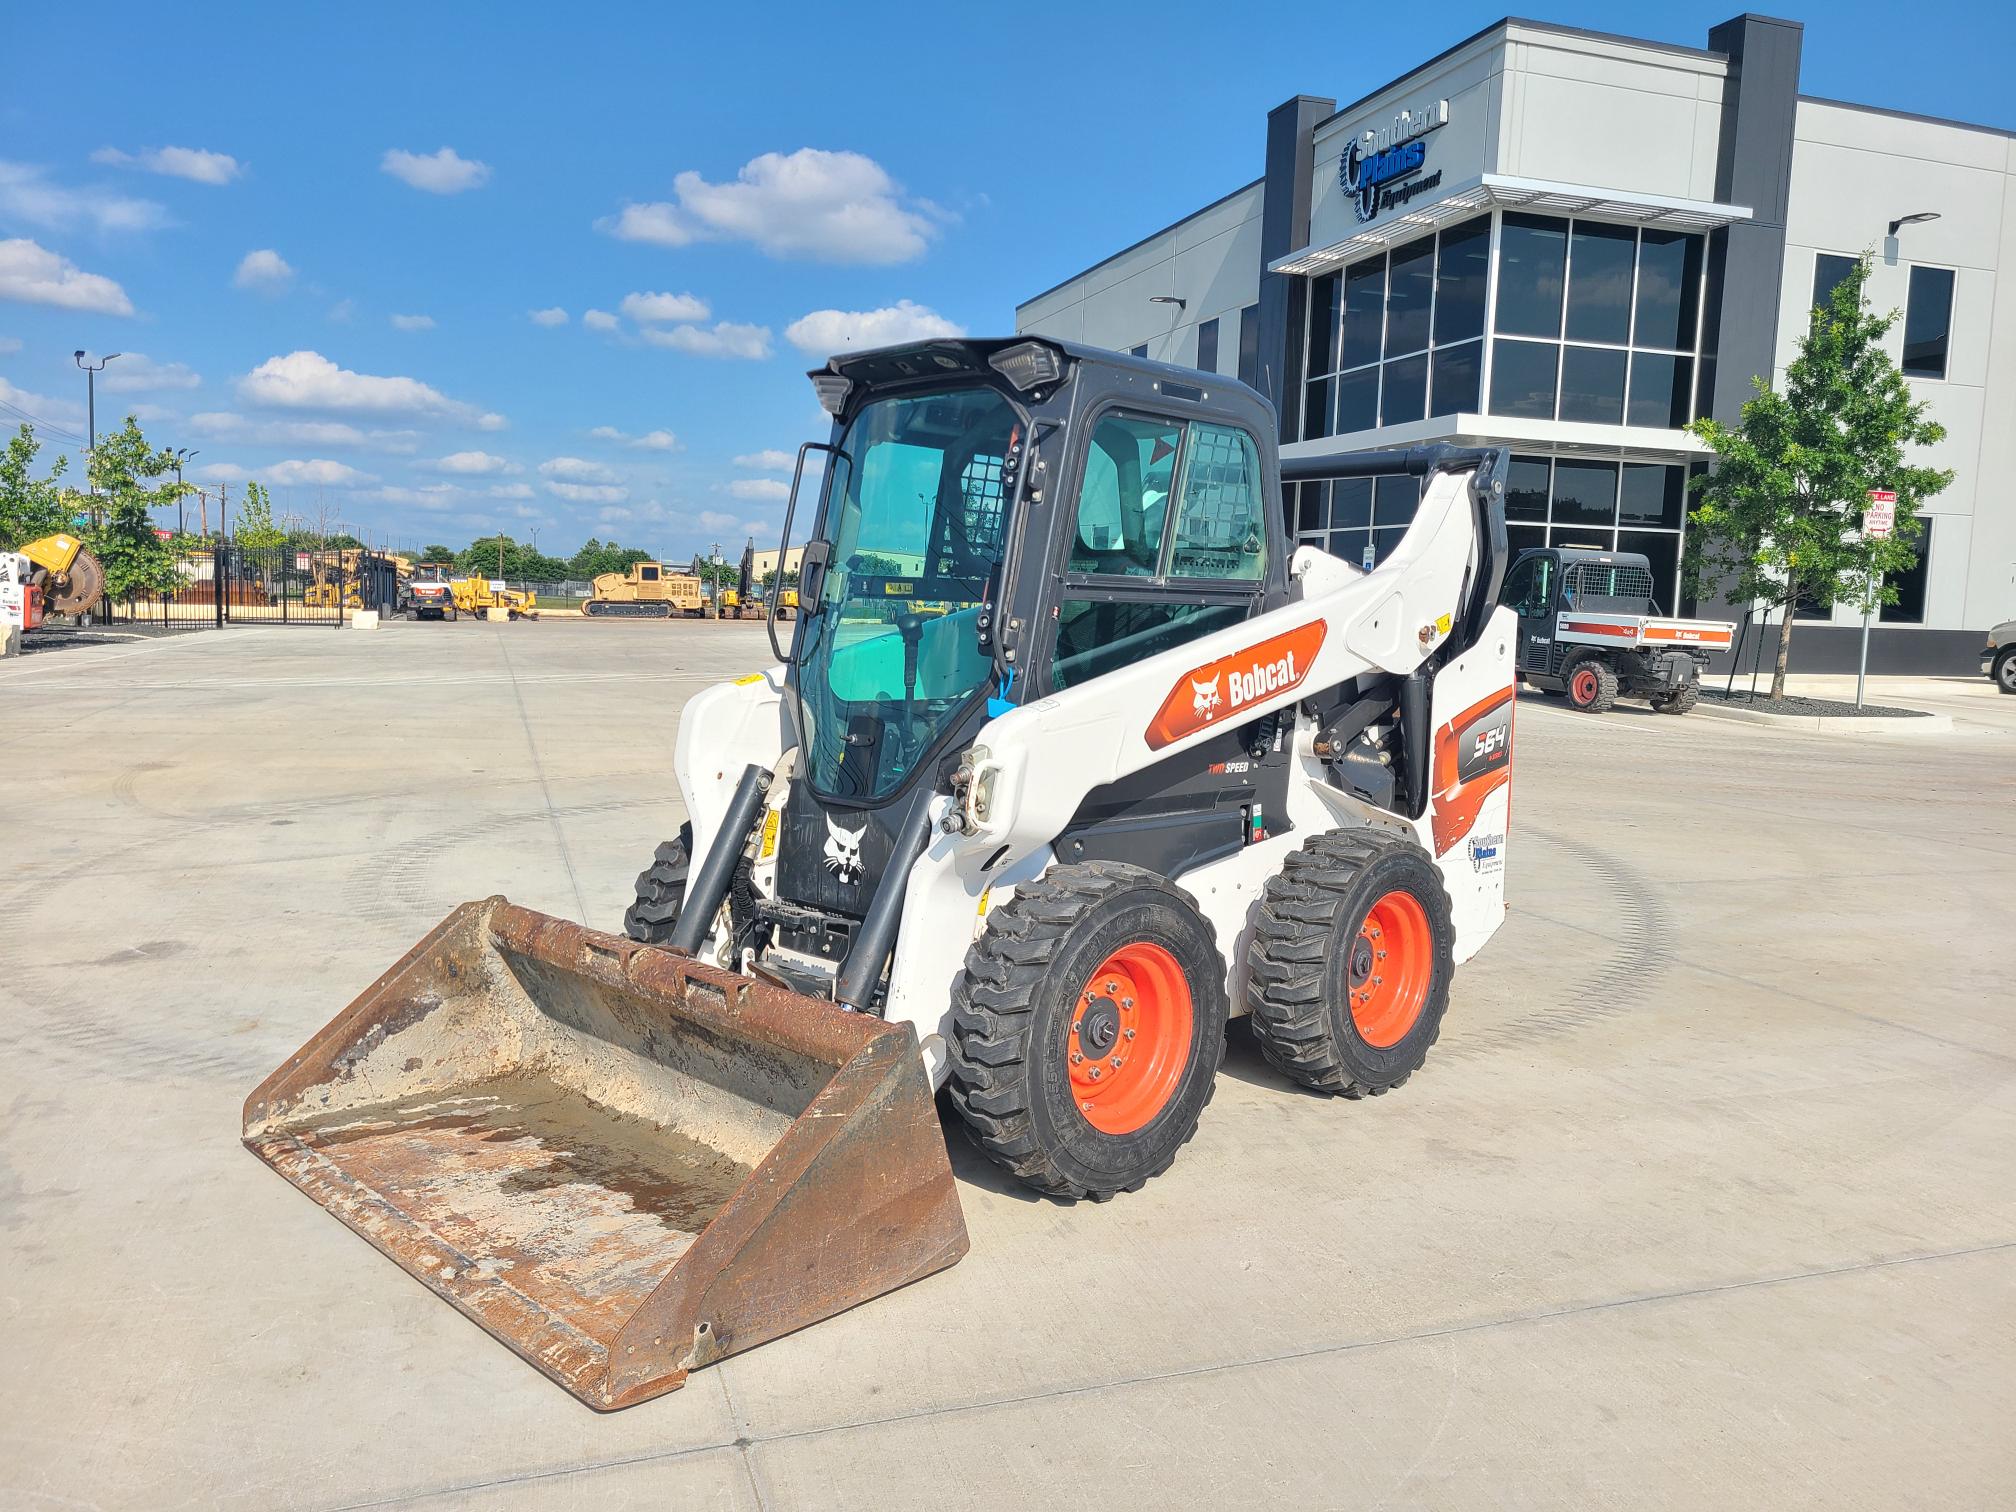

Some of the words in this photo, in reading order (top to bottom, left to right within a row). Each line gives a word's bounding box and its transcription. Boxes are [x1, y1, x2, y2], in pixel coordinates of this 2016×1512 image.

[1355, 99, 1448, 161] Southern
[1359, 141, 1426, 190] Plains
[1380, 169, 1442, 210] Equipment
[1866, 512, 1891, 520] PARKING
[1876, 503, 1884, 511] NO
[1536, 636, 1551, 644] Bobcat
[1682, 632, 1700, 640] Bobcat
[1229, 650, 1295, 708] Bobcat
[1473, 725, 1506, 758] S64
[1225, 762, 1249, 774] SPEED
